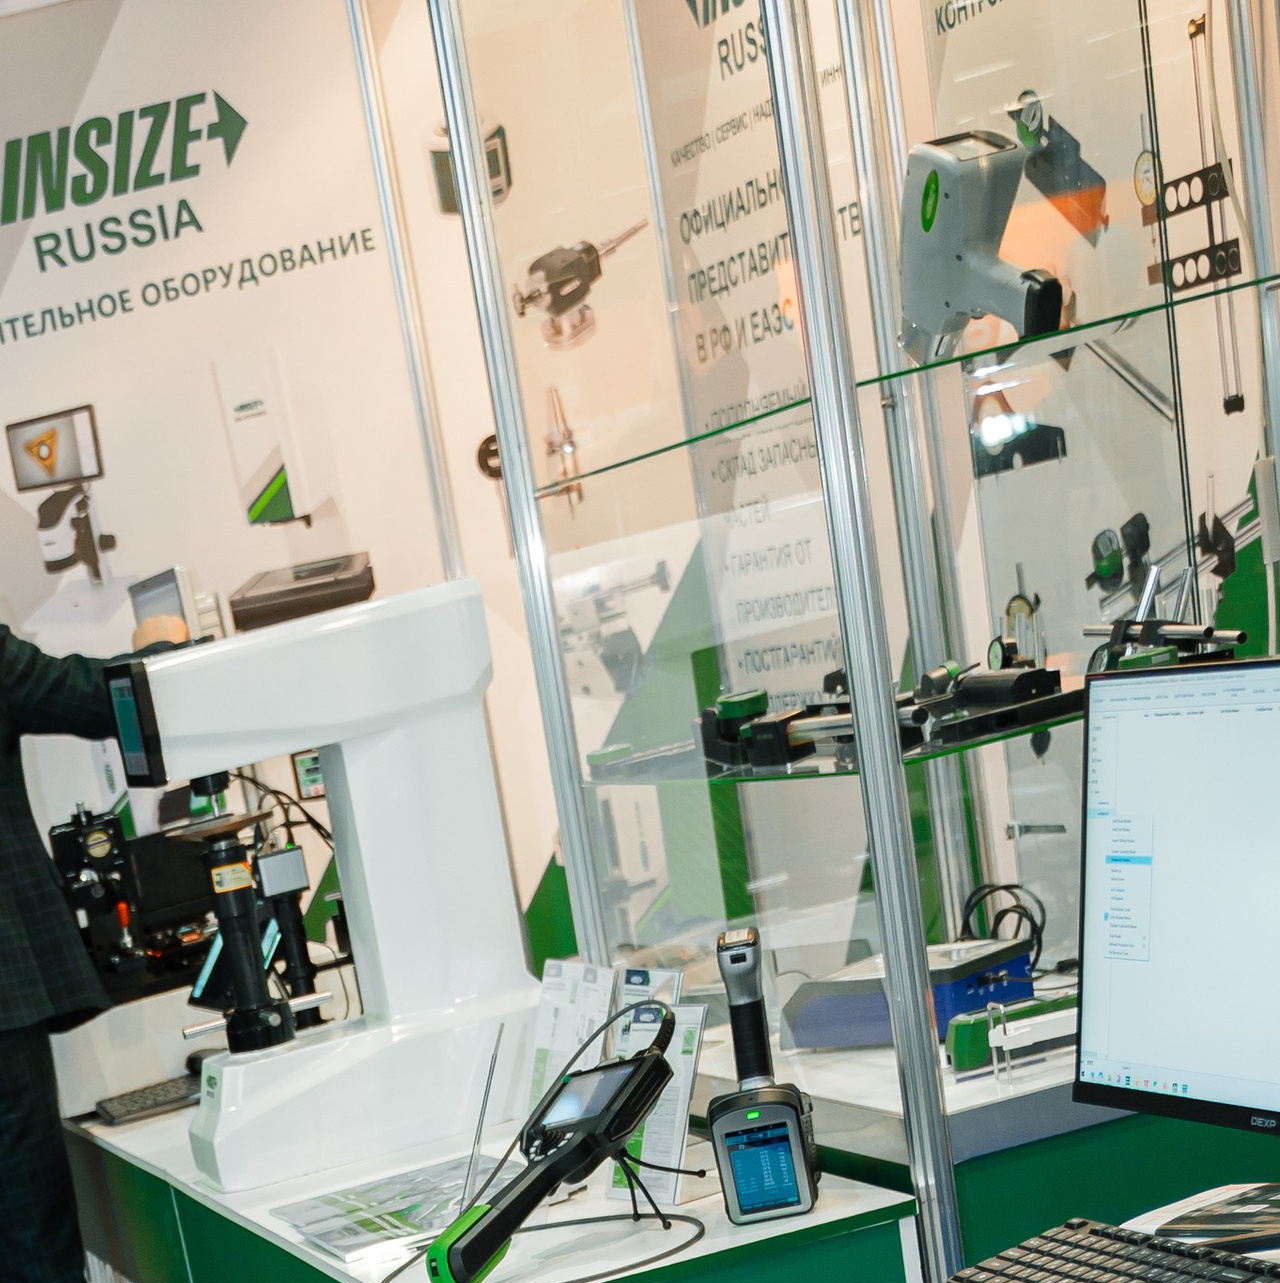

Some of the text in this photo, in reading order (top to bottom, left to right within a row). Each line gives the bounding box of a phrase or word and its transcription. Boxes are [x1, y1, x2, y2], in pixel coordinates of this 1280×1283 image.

[715, 111, 748, 145] СЕРВИС
[0, 91, 207, 226] INSIZE
[33, 198, 204, 272] RUSSIA
[142, 228, 377, 308] ОБОРУДОВАНИЕ
[695, 298, 795, 364] В РФ И ЕАЭС
[717, 451, 757, 483] СКЛАД
[730, 539, 812, 578] ГАРАНТИЯ ОТ
[736, 586, 836, 625] ПРОИЗВОДИТЕЛ
[1251, 1116, 1277, 1128] DEXP
